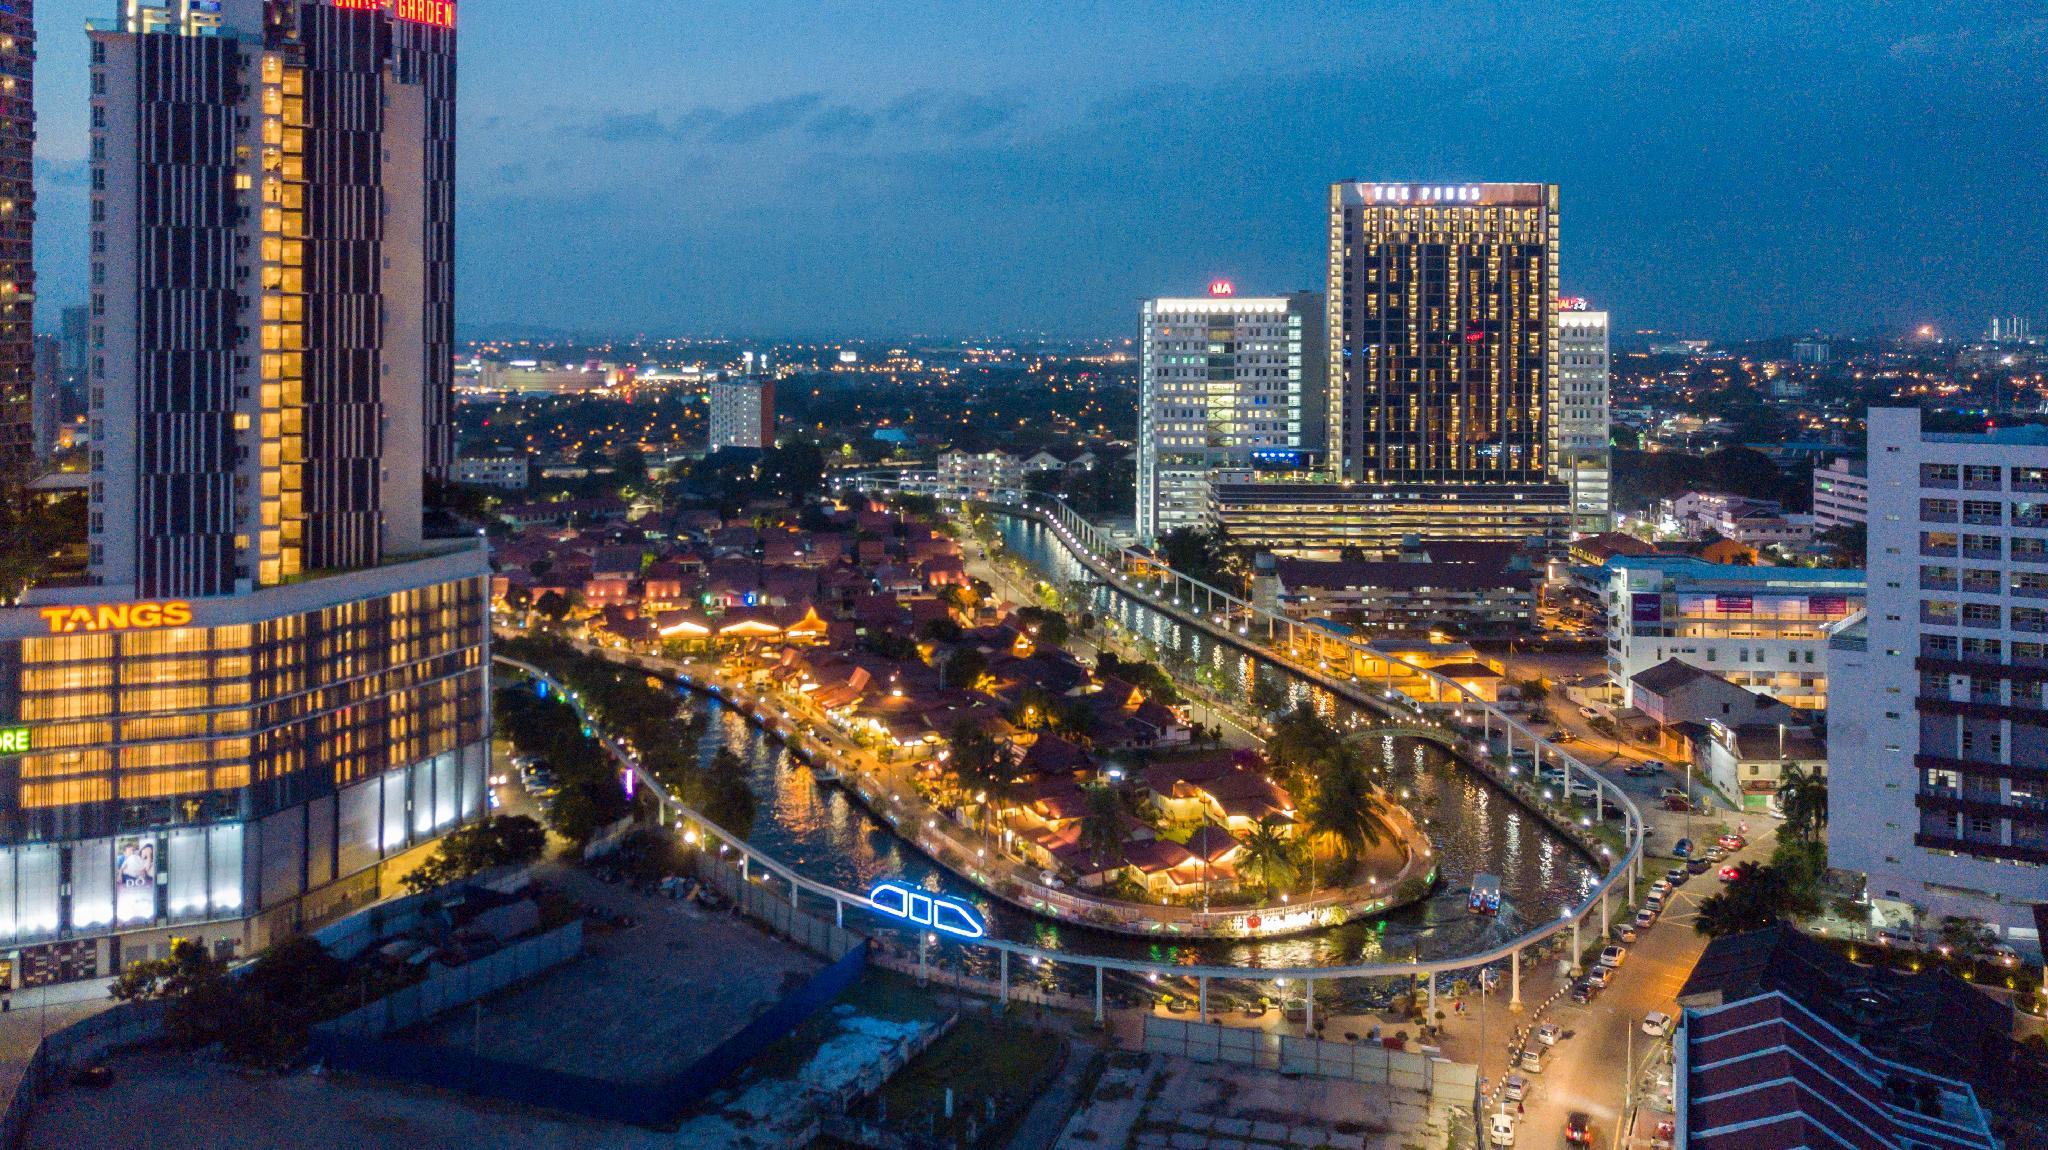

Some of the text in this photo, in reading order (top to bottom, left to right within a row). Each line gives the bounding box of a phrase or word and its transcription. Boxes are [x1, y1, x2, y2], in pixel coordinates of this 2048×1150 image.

[398, 0, 452, 27] GARDEN
[1375, 186, 1480, 200] THE PINES
[40, 601, 193, 633] TANGS
[0, 730, 29, 752] RE
